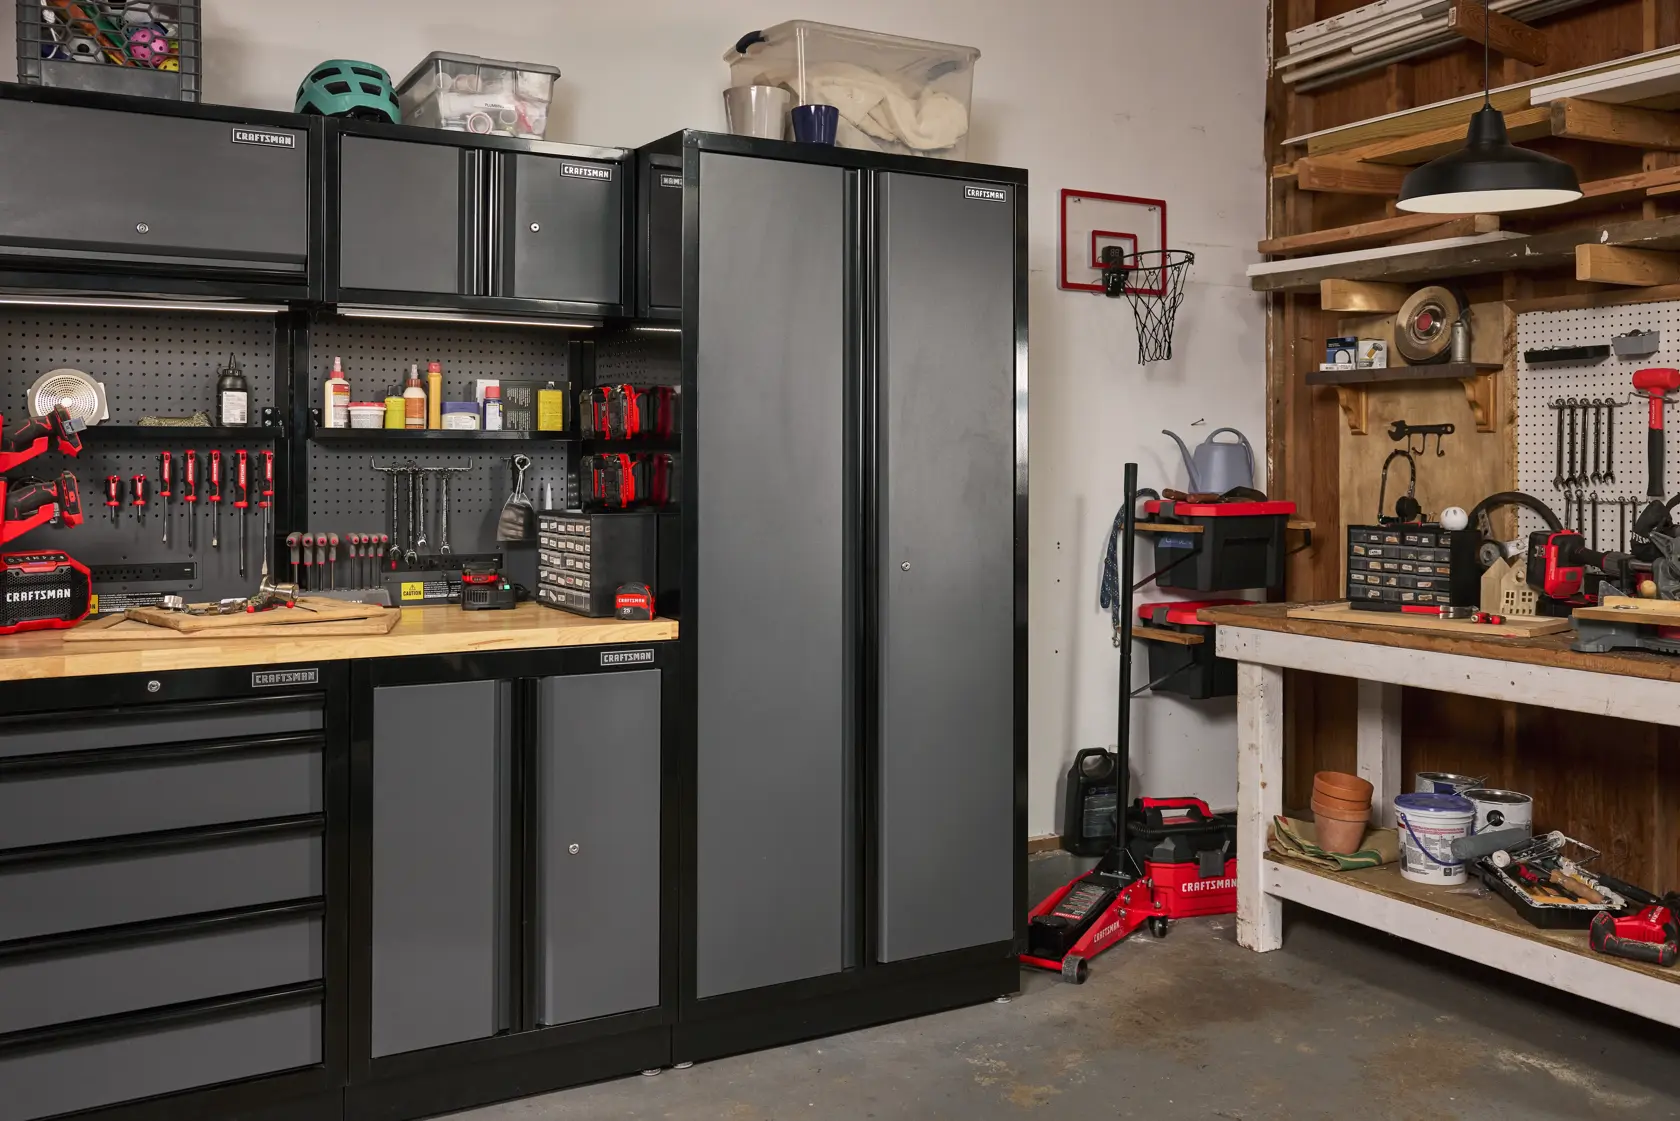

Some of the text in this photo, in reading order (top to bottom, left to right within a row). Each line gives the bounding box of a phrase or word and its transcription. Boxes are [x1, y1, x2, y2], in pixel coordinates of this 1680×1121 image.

[236, 131, 292, 145] CRAFTSMAN
[564, 166, 609, 178] CRAFTSMAN
[967, 189, 1004, 199] CRAFTSMAN
[6, 588, 71, 602] CRAFTSMAN
[603, 651, 652, 663] CRAFTSMAN
[255, 671, 315, 683] CRAFTSMAN
[1181, 878, 1237, 892] CRAFTSMAN
[1093, 919, 1120, 943] CRAFTSMAN
